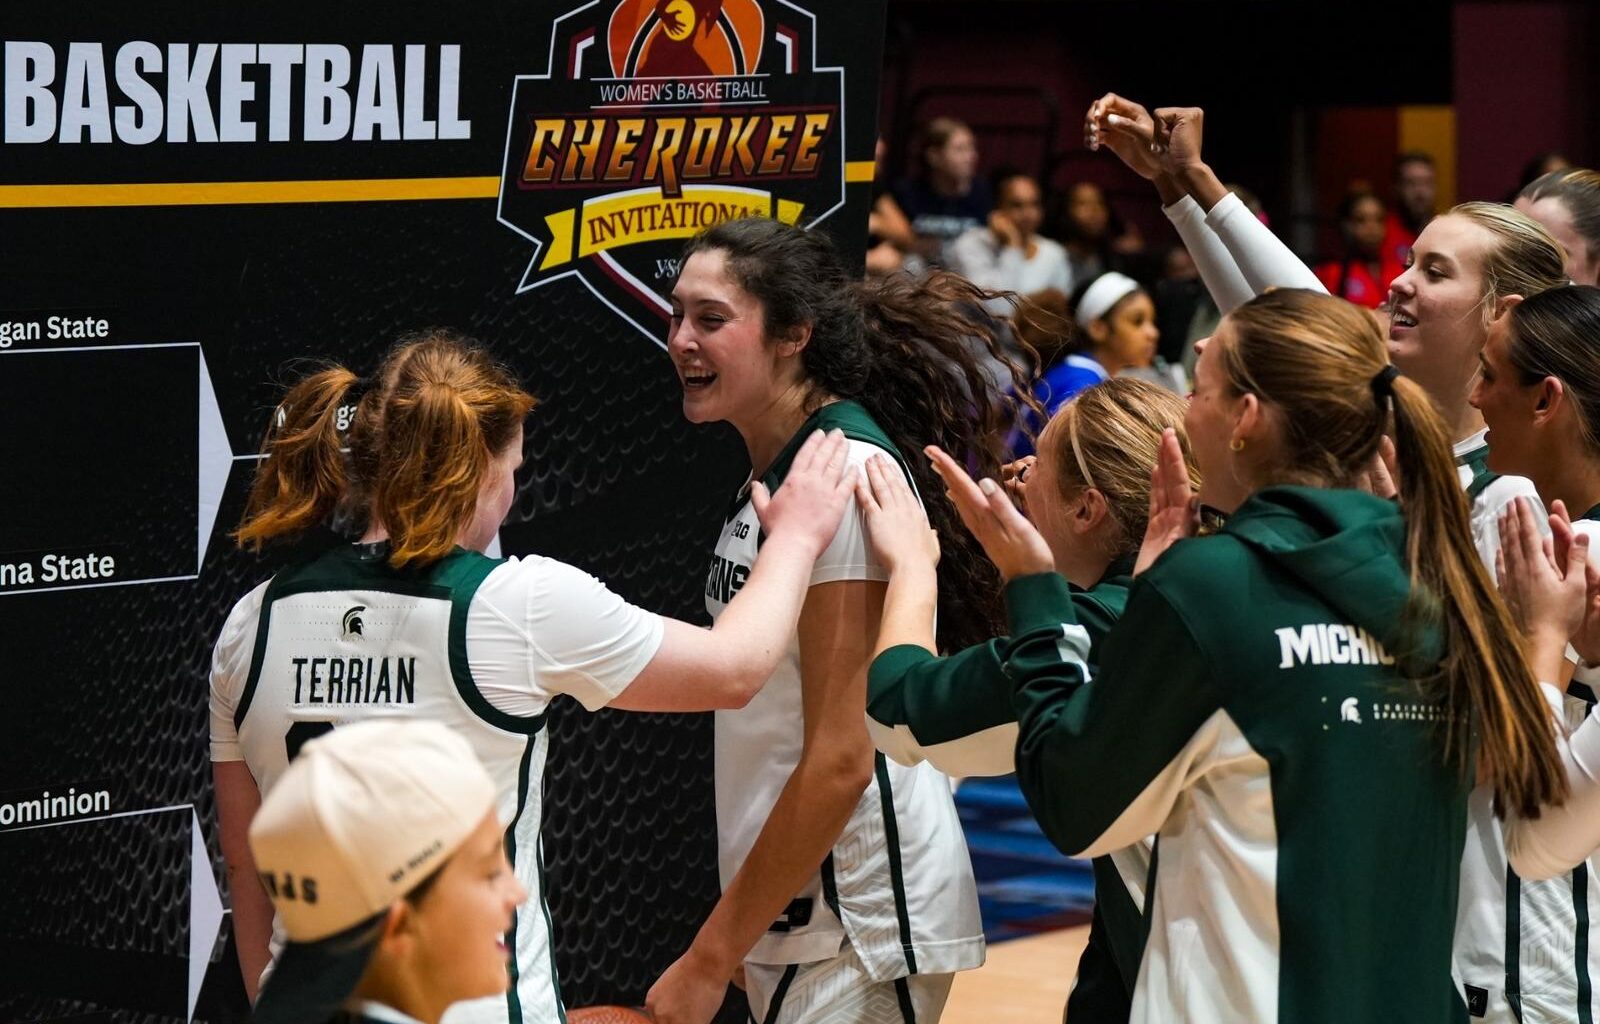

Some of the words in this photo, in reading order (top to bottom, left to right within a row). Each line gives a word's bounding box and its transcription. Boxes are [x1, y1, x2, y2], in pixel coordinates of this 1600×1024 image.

[4, 40, 471, 145] BASKETBALL
[600, 83, 673, 102] WOMEN'S
[677, 80, 767, 100] BASKETBALL
[522, 113, 830, 195] CHEROKEE
[587, 202, 762, 245] INVITATIONA
[47, 315, 109, 339] State
[0, 562, 34, 586] na
[41, 553, 115, 582] State
[292, 657, 416, 704] TERRIAN
[0, 787, 110, 825] ominion
